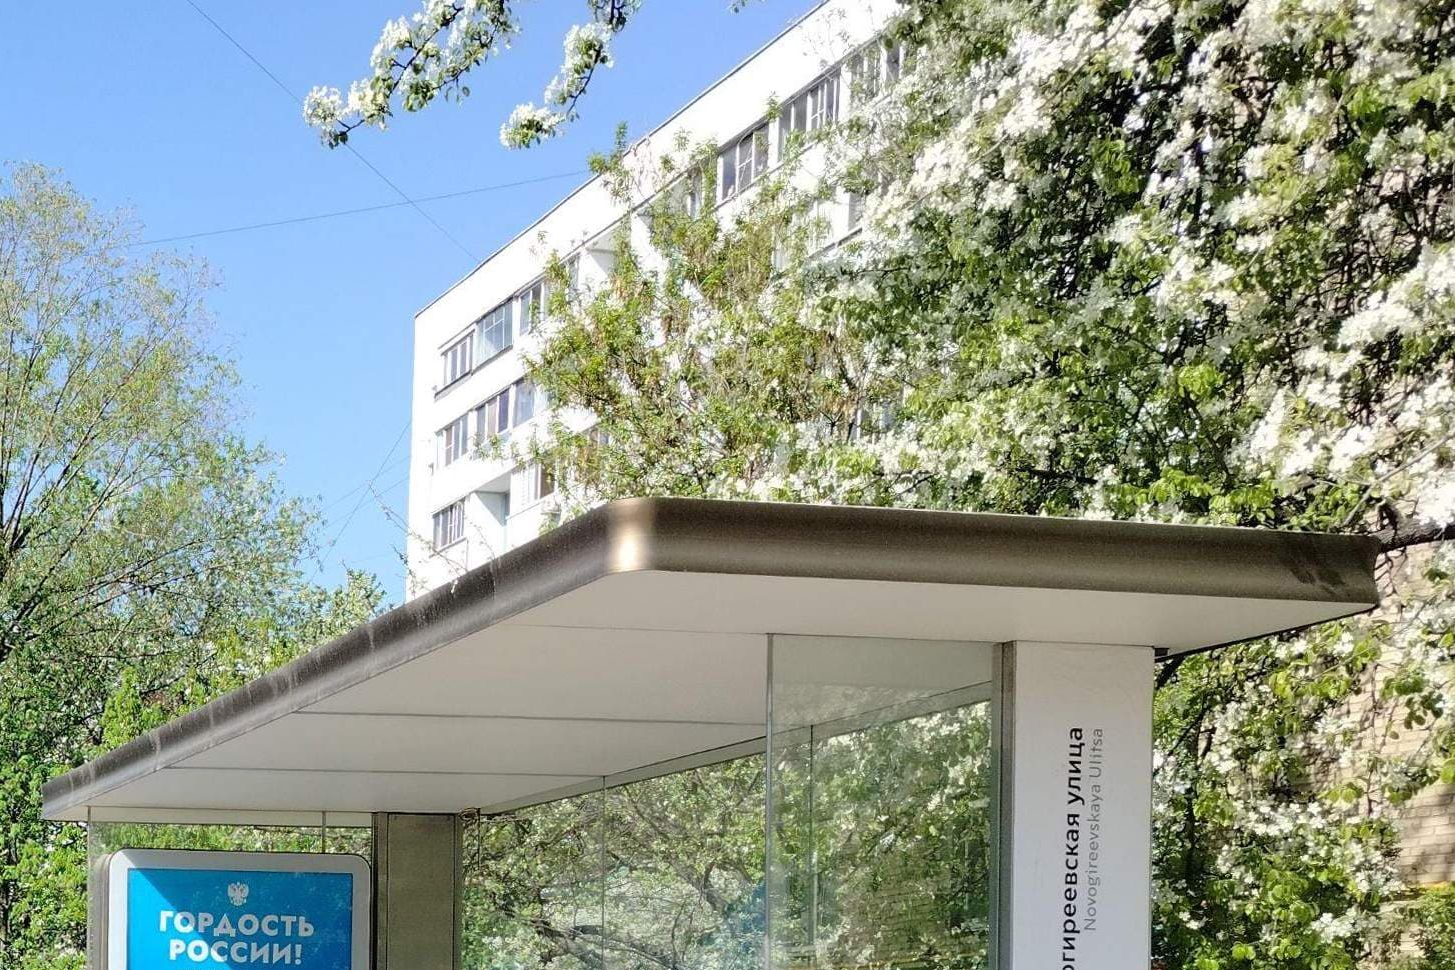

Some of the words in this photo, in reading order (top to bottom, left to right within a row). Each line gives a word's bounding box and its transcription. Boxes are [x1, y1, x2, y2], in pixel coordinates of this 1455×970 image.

[1067, 726, 1085, 805] улица
[1089, 727, 1103, 778] Ulitsa
[1084, 784, 1101, 931] Novogireevskaya
[158, 910, 315, 938] ГОРДОСТЬ
[168, 938, 303, 966] РОССИИ!
